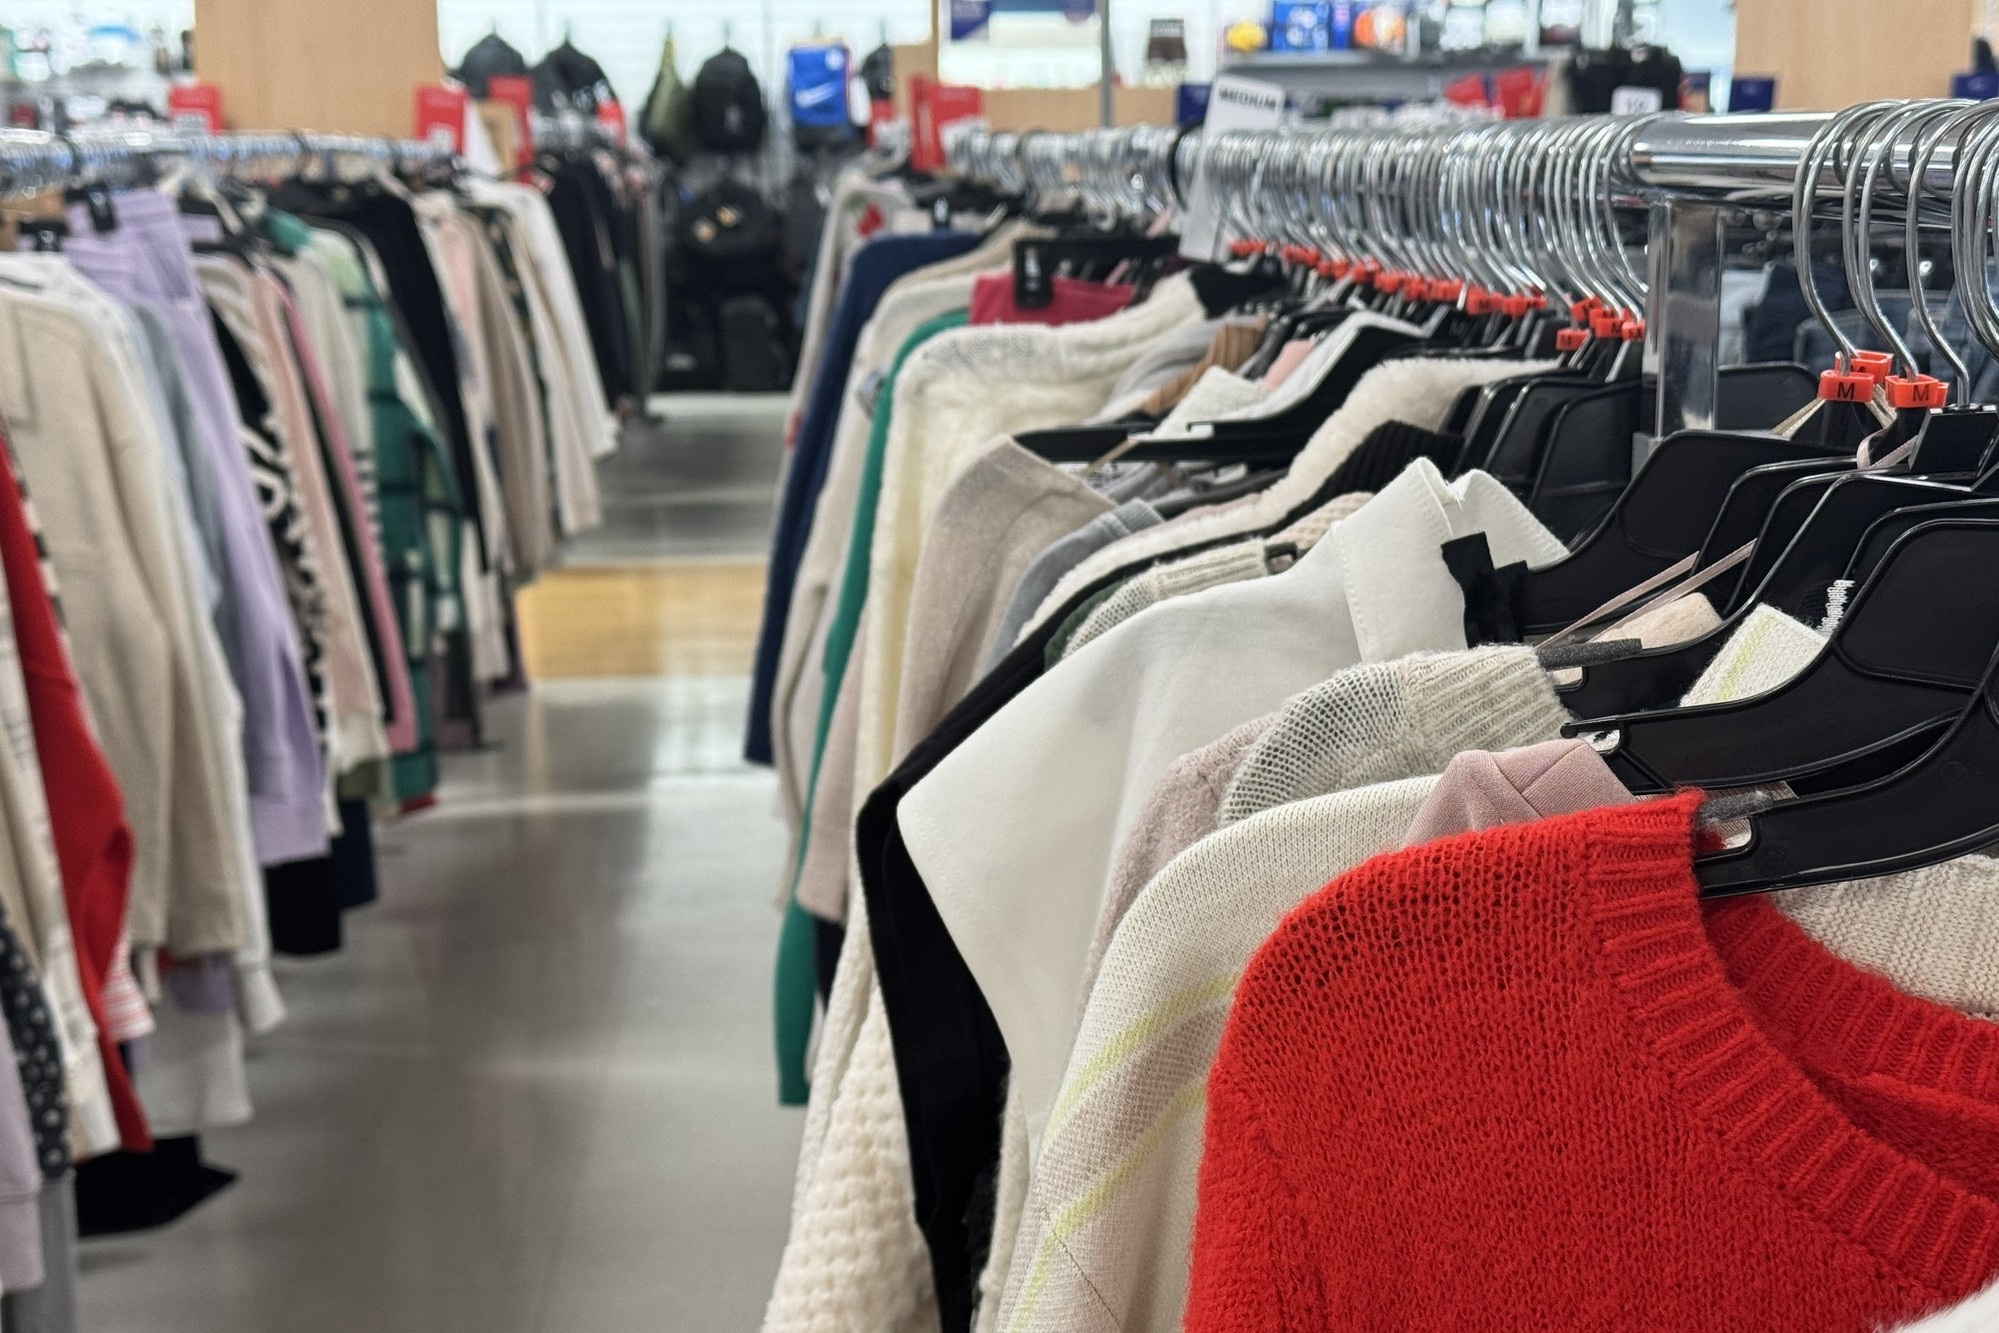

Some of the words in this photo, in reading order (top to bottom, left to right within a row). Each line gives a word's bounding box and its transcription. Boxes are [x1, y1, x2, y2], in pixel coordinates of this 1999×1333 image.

[1220, 88, 1276, 110] MEDIUM
[1837, 382, 1855, 400] M
[1912, 384, 1929, 402] M
